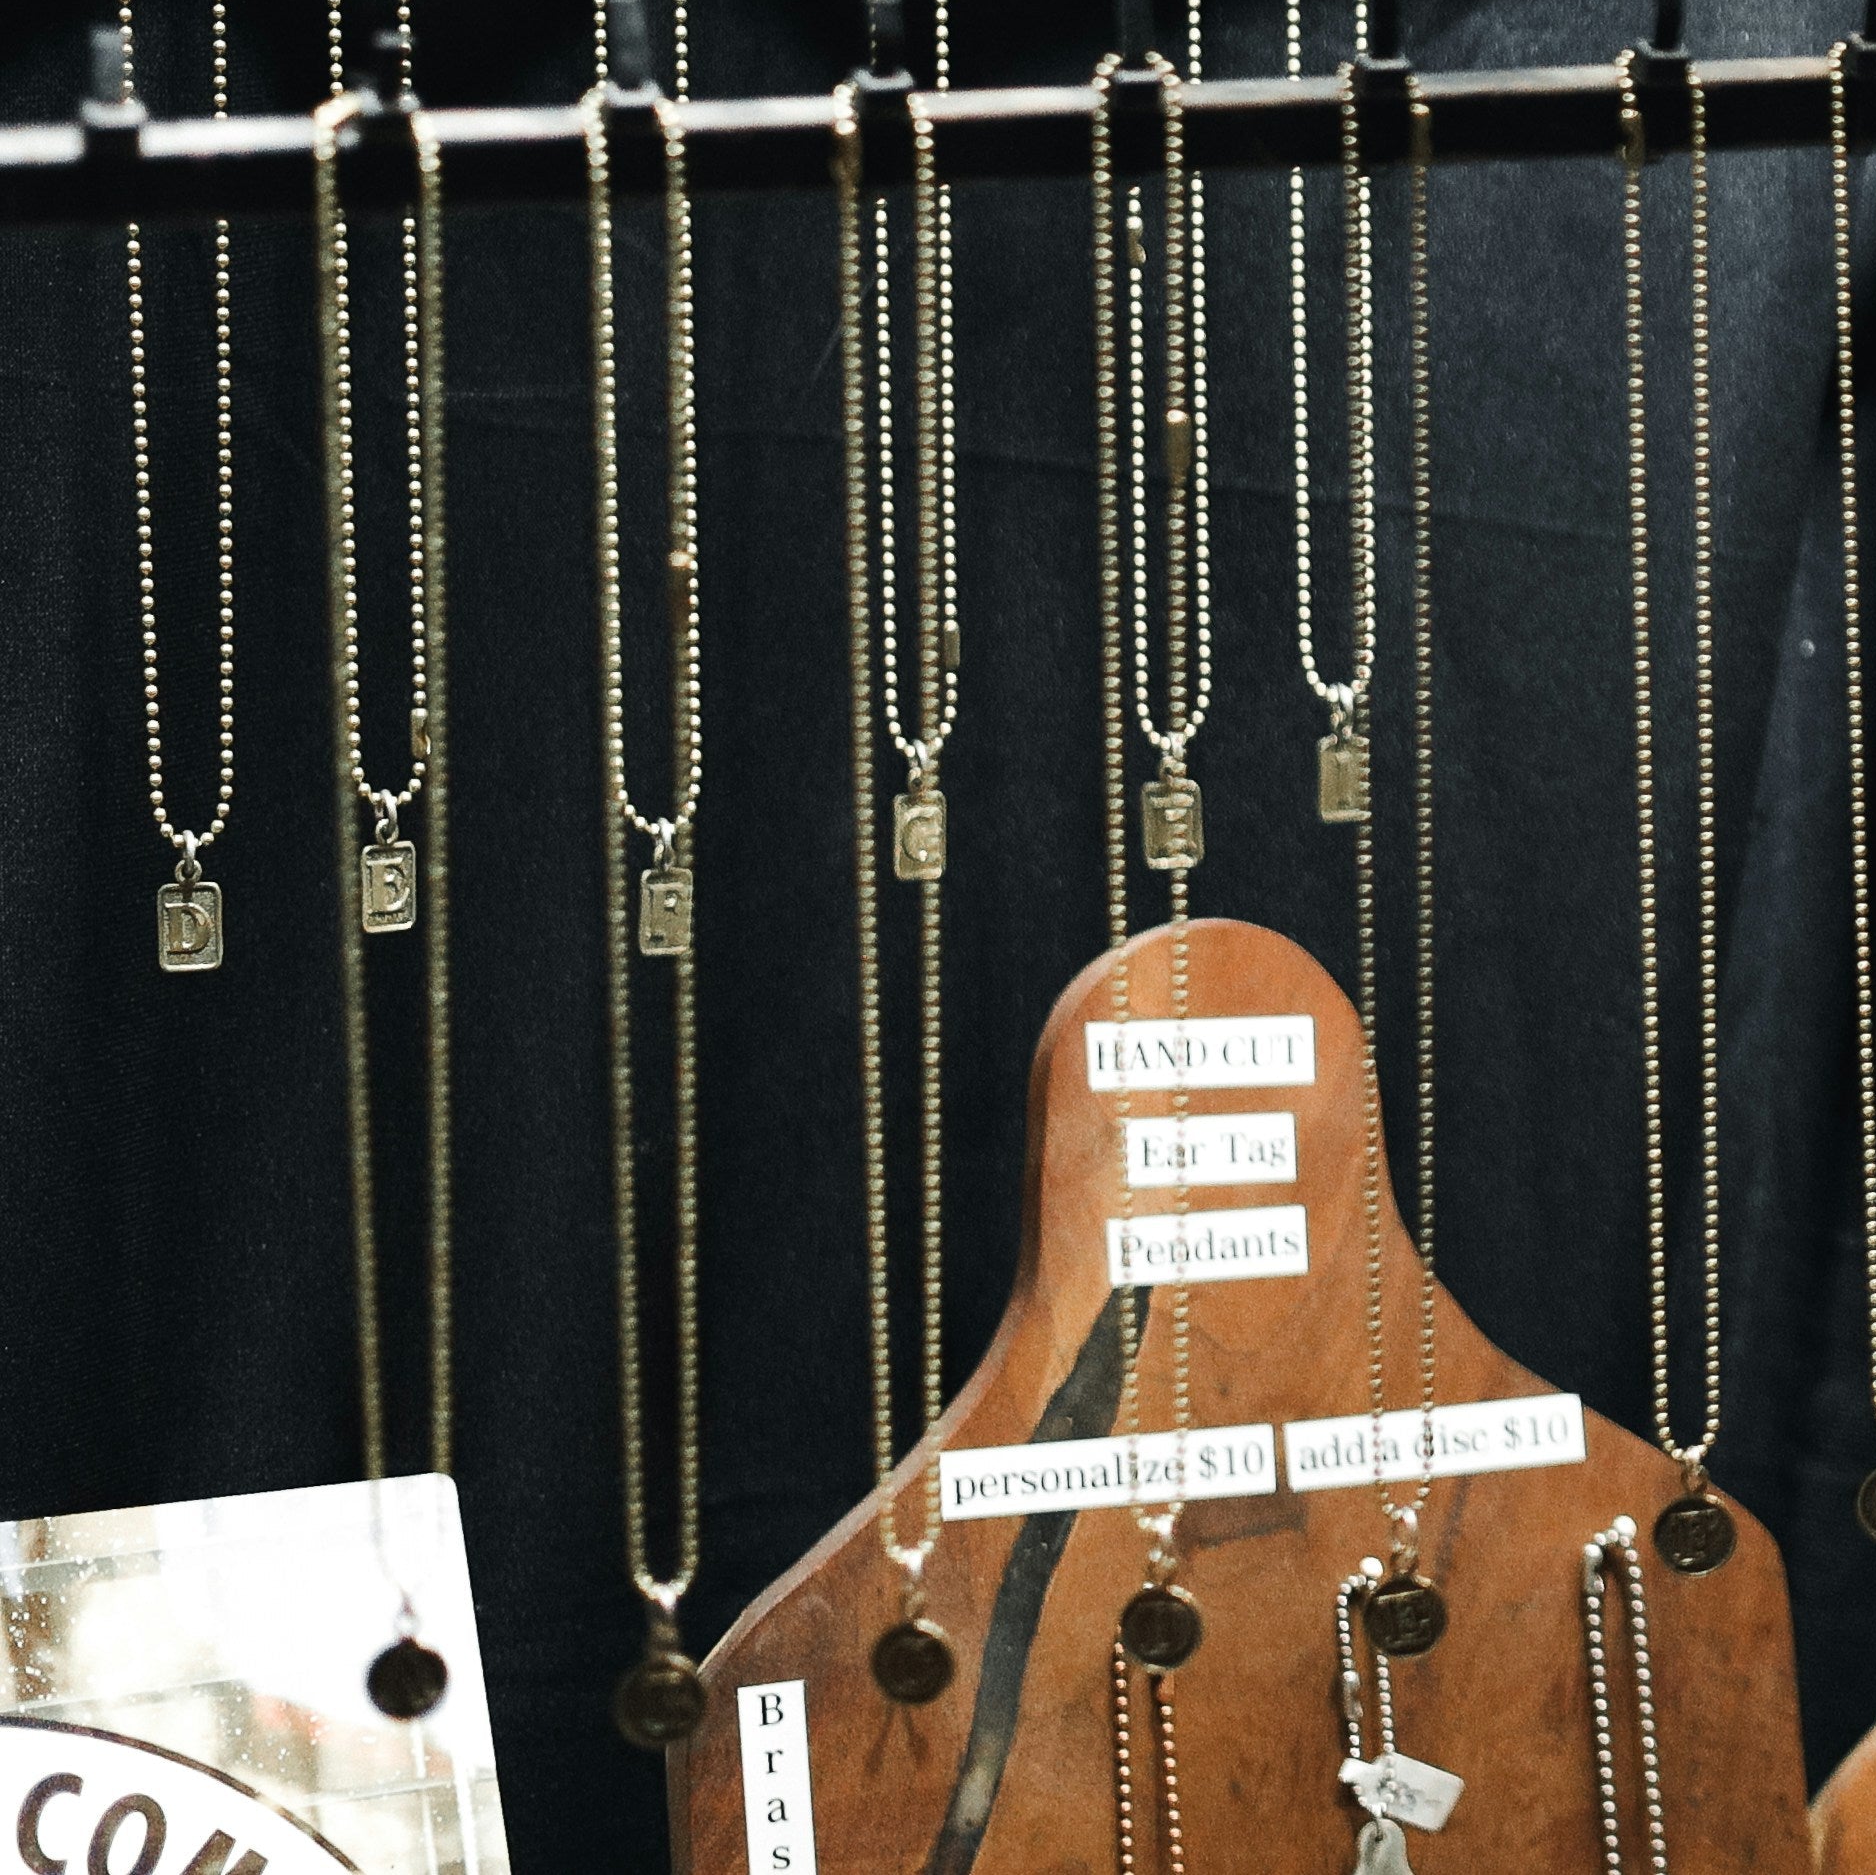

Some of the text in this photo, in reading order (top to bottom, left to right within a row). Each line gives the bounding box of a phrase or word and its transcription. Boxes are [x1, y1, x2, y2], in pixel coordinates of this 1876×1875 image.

[164, 901, 213, 956] D
[1095, 1032, 1304, 1072] HAND CUT
[1220, 1131, 1288, 1169] Tag
[1119, 1227, 1301, 1269] Pendants
[1198, 1439, 1265, 1480] $10
[1299, 1430, 1367, 1473] add
[1503, 1412, 1570, 1452] $10
